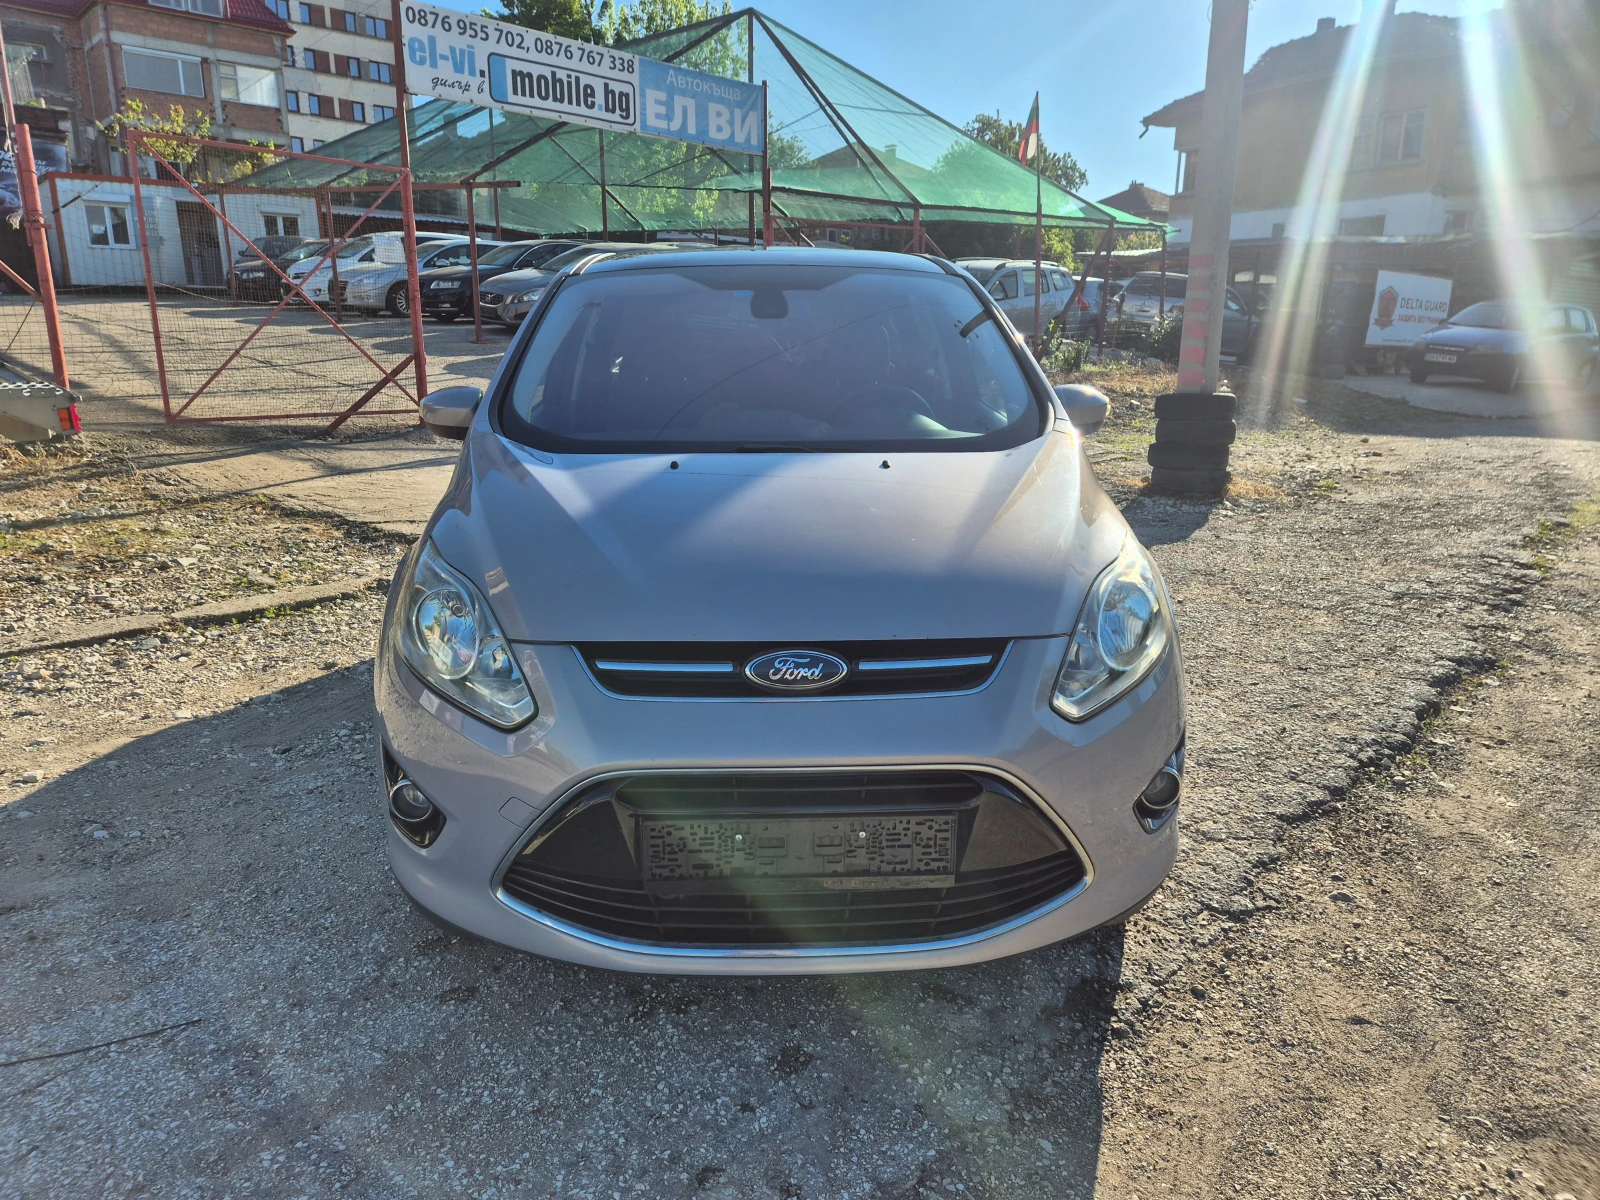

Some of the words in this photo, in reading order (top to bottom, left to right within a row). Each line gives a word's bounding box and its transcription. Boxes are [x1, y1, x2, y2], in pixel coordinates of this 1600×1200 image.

[405, 6, 452, 33] 0876
[456, 18, 490, 42] 955
[494, 27, 530, 54] 702,
[534, 37, 574, 61] 0876
[577, 46, 604, 68] 767
[608, 55, 635, 74] 338
[511, 69, 630, 119] mobile.bg
[666, 69, 741, 102] Автокъща
[645, 88, 696, 135] ЕЛ
[708, 102, 758, 146] ВИ
[1400, 298, 1423, 310] DELTA
[1425, 301, 1447, 312] GUARD
[768, 657, 824, 680] Ford
